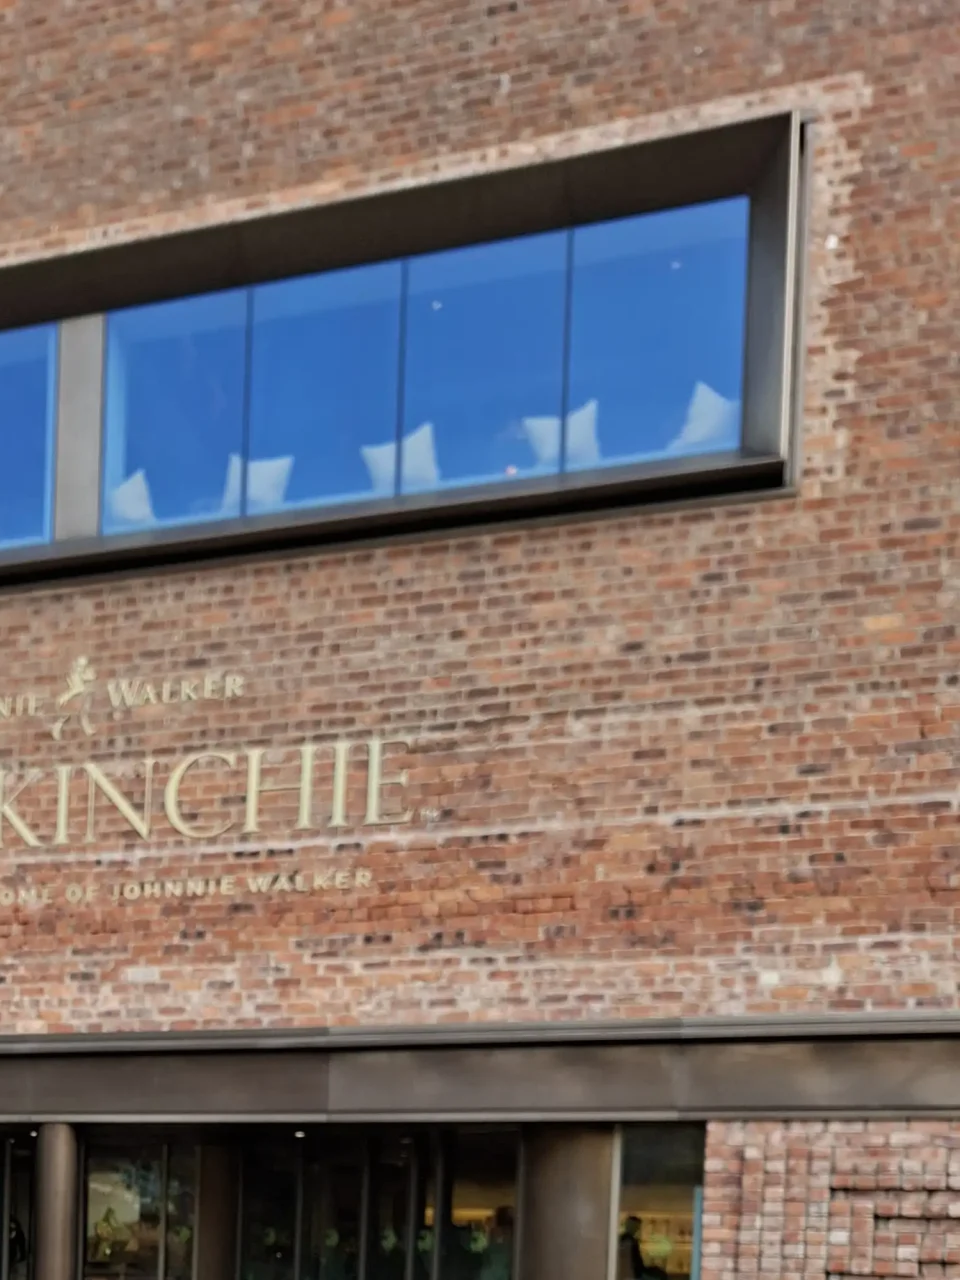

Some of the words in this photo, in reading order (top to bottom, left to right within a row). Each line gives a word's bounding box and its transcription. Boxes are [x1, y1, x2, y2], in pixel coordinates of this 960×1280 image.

[107, 674, 246, 708] WALKER
[65, 884, 100, 902] OF
[111, 875, 237, 903] JOHNNIE
[248, 869, 373, 894] WALKER
